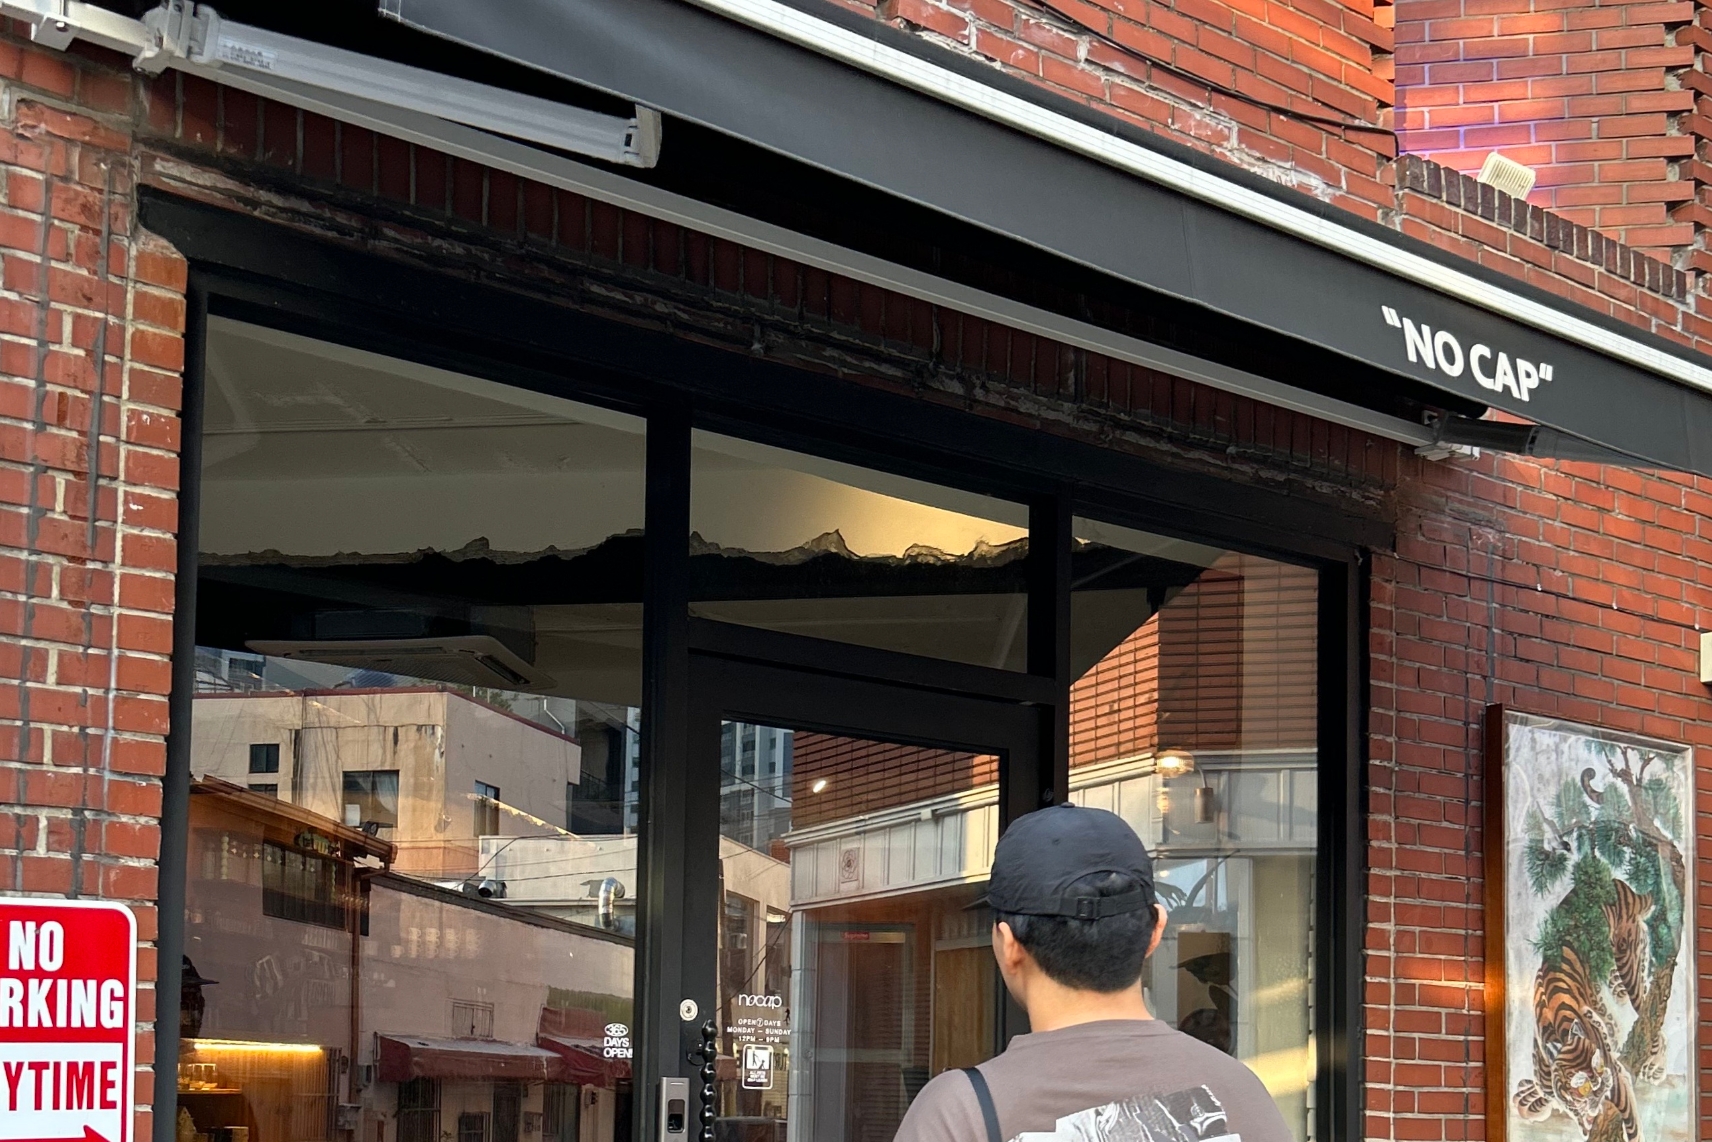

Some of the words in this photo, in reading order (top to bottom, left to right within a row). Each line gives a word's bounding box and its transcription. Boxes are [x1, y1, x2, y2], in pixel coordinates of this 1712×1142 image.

[8, 920, 65, 972] NO
[738, 1018, 756, 1026] OPEN
[764, 1019, 781, 1027] DAYS
[605, 1024, 628, 1036] 365
[727, 1026, 755, 1034] MONDAY
[765, 1028, 792, 1036] SUNDAY
[604, 1036, 630, 1047] DAYS
[603, 1047, 633, 1059] OPEN!
[3, 1061, 117, 1111] YTIME
